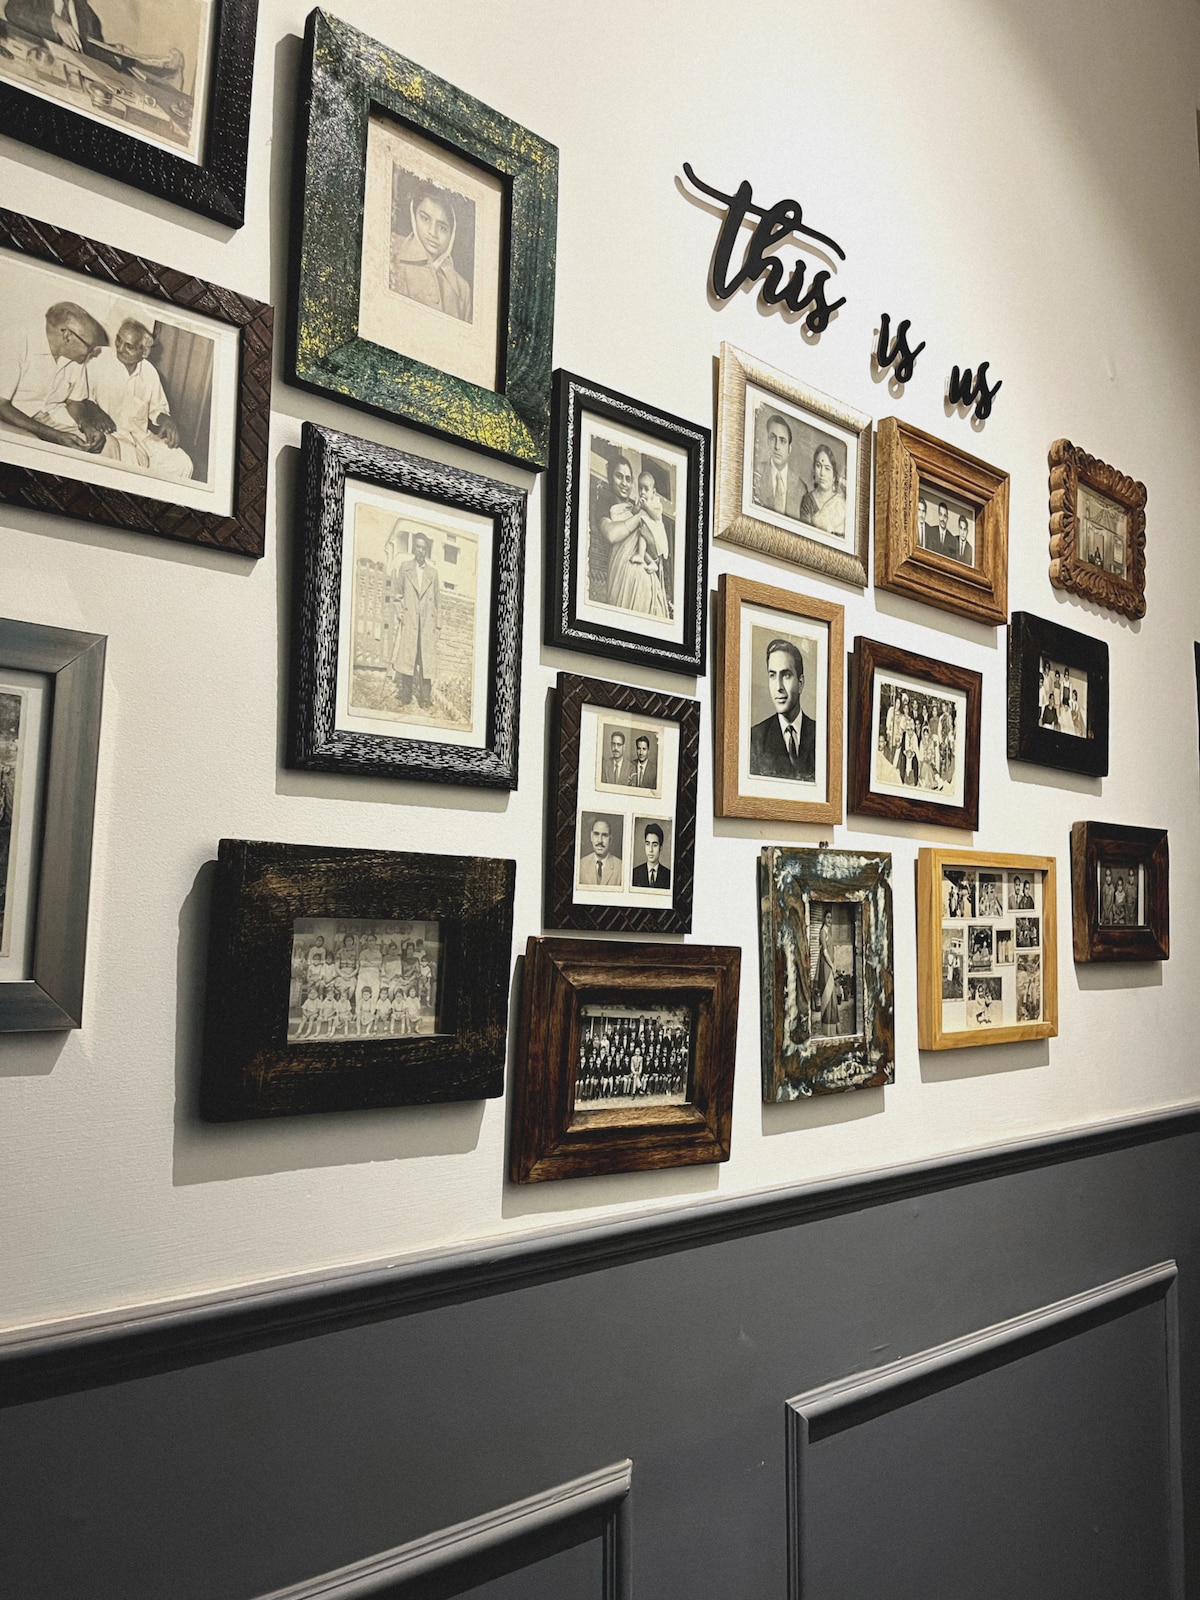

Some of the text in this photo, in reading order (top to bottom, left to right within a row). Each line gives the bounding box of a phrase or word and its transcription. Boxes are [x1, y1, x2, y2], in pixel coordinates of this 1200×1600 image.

[683, 163, 1002, 420] this is us
